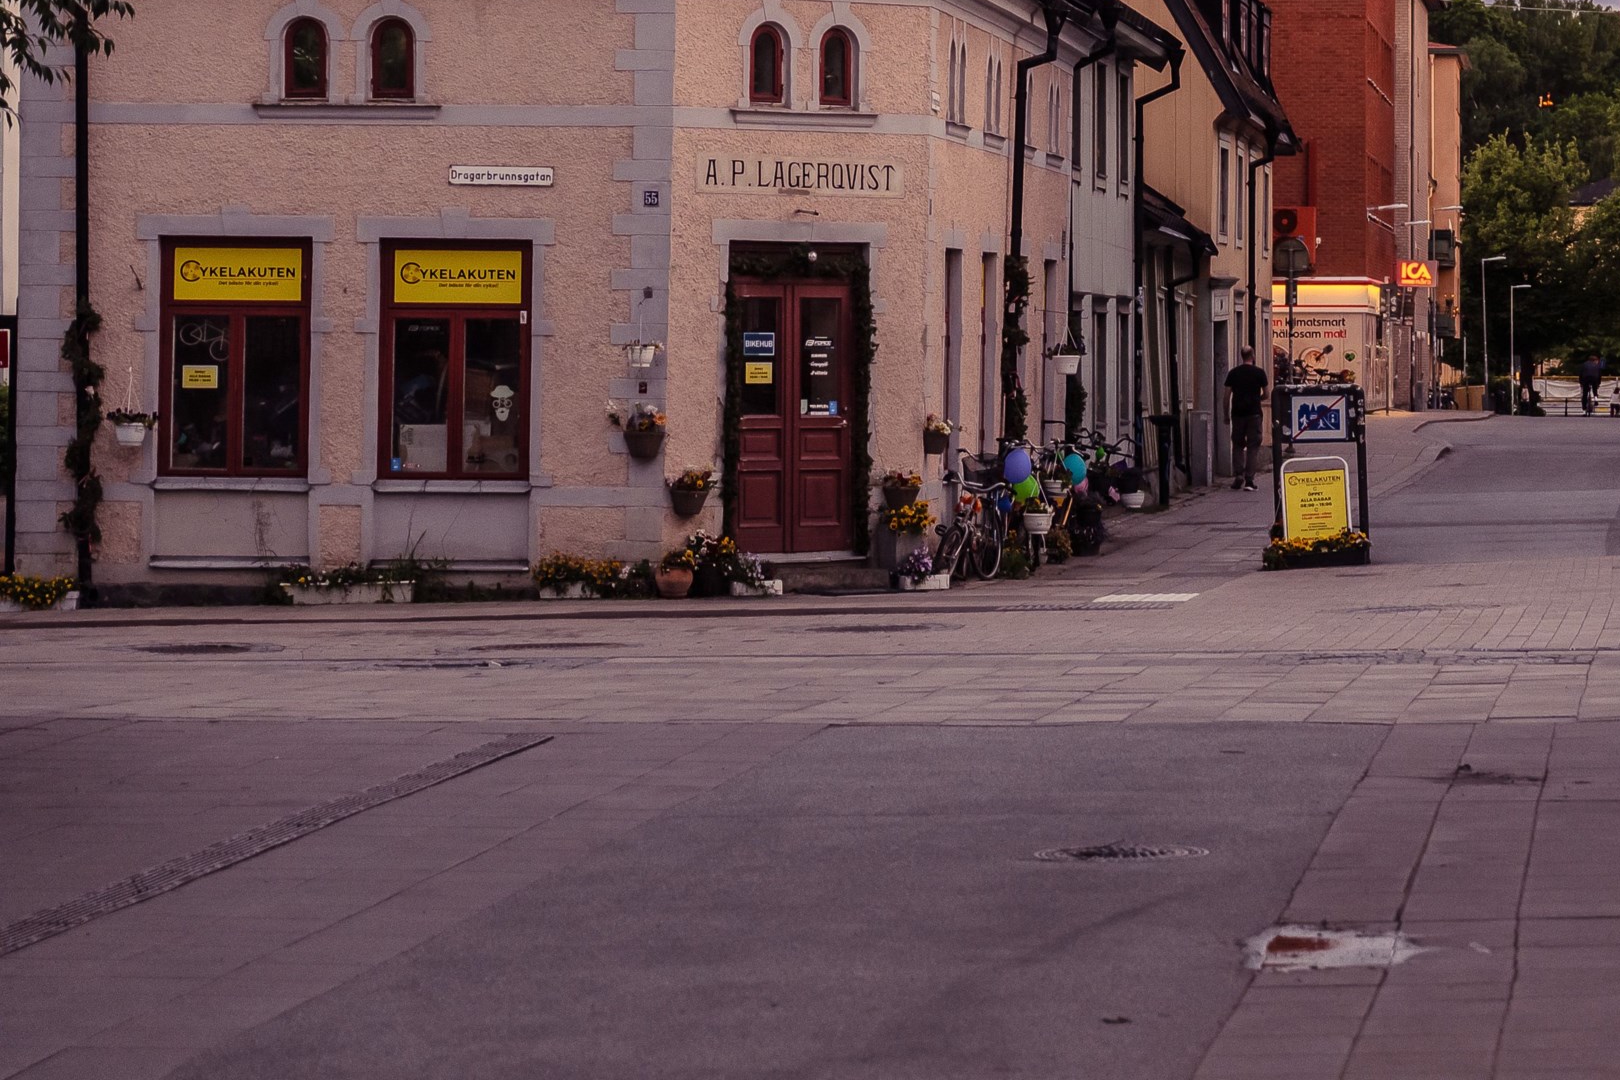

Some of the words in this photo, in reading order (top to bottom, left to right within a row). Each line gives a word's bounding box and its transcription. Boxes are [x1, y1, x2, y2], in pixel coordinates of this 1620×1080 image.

[451, 170, 551, 183] Dragarbrunnsgatan
[757, 161, 896, 191] LAGERQVIST
[644, 192, 658, 205] 55
[180, 260, 296, 282] CYKELAKUTEN
[400, 262, 516, 284] CYKELAKUTEN
[1401, 262, 1431, 279] ICA
[1272, 328, 1321, 338] hälosam
[1323, 328, 1347, 338] mat!
[745, 340, 773, 348] BIKEHUB
[1288, 475, 1341, 486] CYKELAKUTEN
